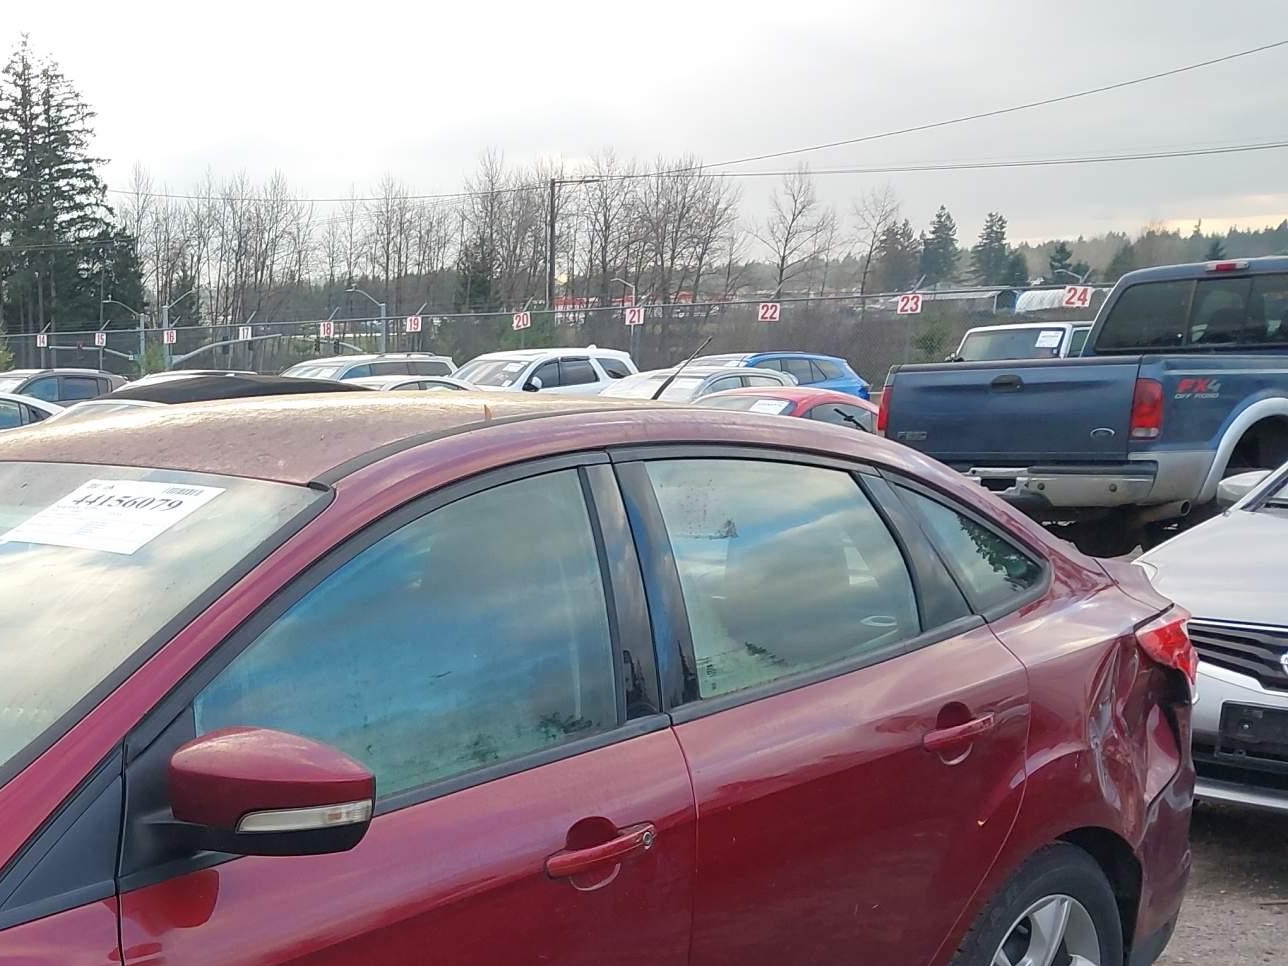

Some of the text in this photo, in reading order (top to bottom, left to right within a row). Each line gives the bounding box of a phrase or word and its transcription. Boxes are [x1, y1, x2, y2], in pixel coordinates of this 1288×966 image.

[899, 295, 920, 312] 23
[1066, 287, 1089, 305] 24
[629, 309, 642, 324] 21
[761, 304, 778, 320] 22
[408, 317, 419, 331] 19
[515, 313, 530, 328] 20
[241, 327, 249, 339] 17
[322, 322, 332, 335] 18
[37, 335, 46, 346] 14
[97, 333, 105, 345] 15
[1177, 377, 1222, 393] FX4
[72, 493, 184, 512] 44156079
